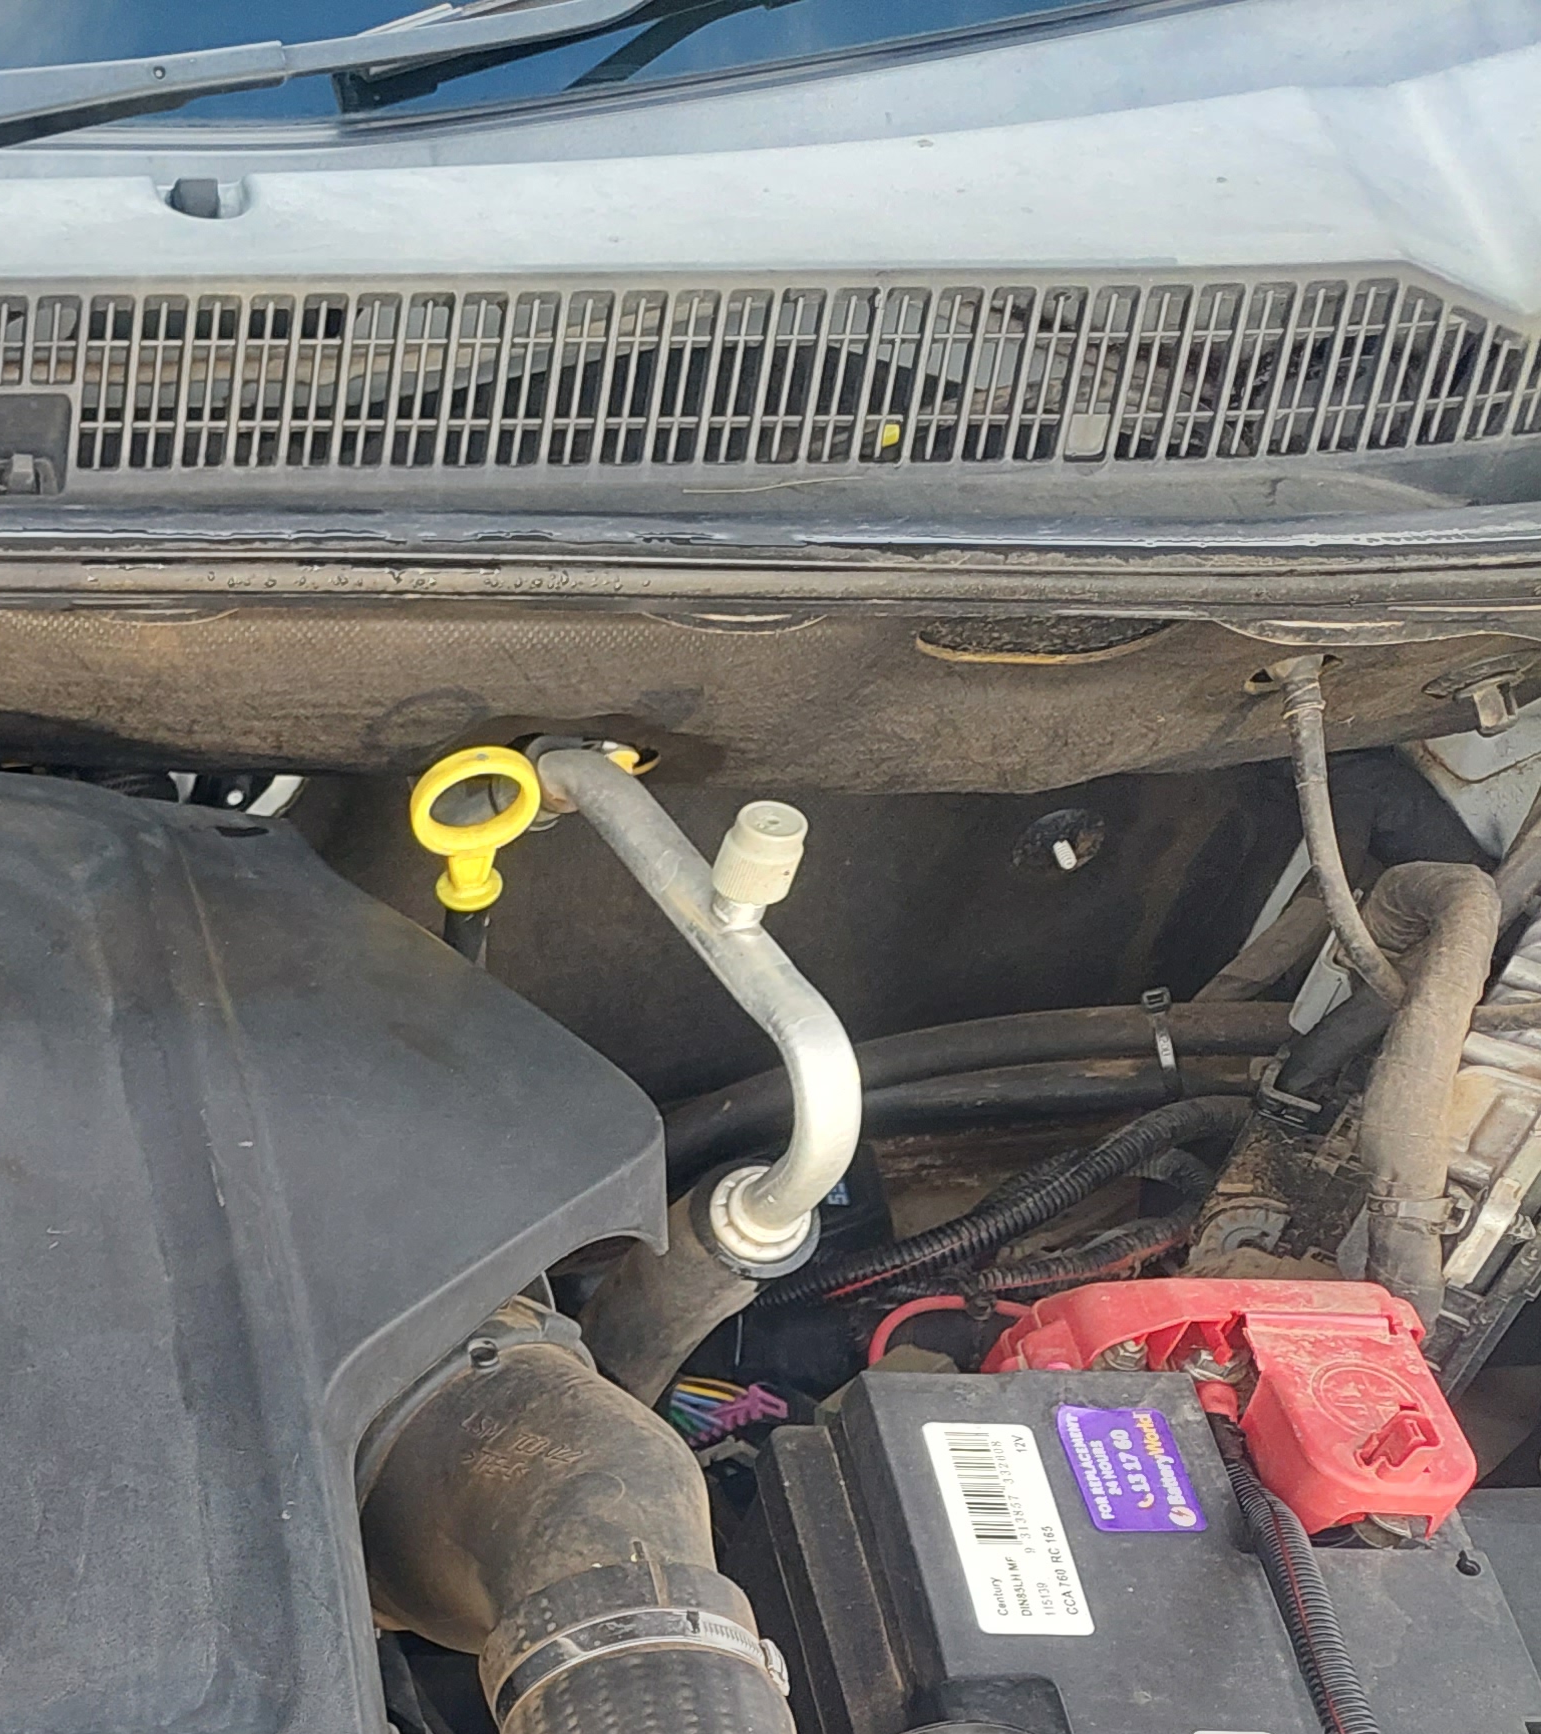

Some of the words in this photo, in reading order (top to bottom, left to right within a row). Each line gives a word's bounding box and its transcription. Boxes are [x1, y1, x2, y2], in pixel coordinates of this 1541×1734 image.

[1011, 1434, 1026, 1452] 12V
[1109, 1429, 1132, 1449] 60
[1062, 1412, 1104, 1494] REPLACEMENT
[1089, 1440, 1116, 1479] HOURS
[1118, 1451, 1141, 1470] 17
[1105, 1480, 1122, 1494] 24
[1127, 1473, 1150, 1491] 13
[1094, 1496, 1114, 1518] FOR
[1040, 1526, 1055, 1542] 165
[1047, 1548, 1062, 1562] RC
[1054, 1568, 1069, 1586] 760
[990, 1577, 1008, 1615] Century
[1061, 1590, 1078, 1614] CCA
